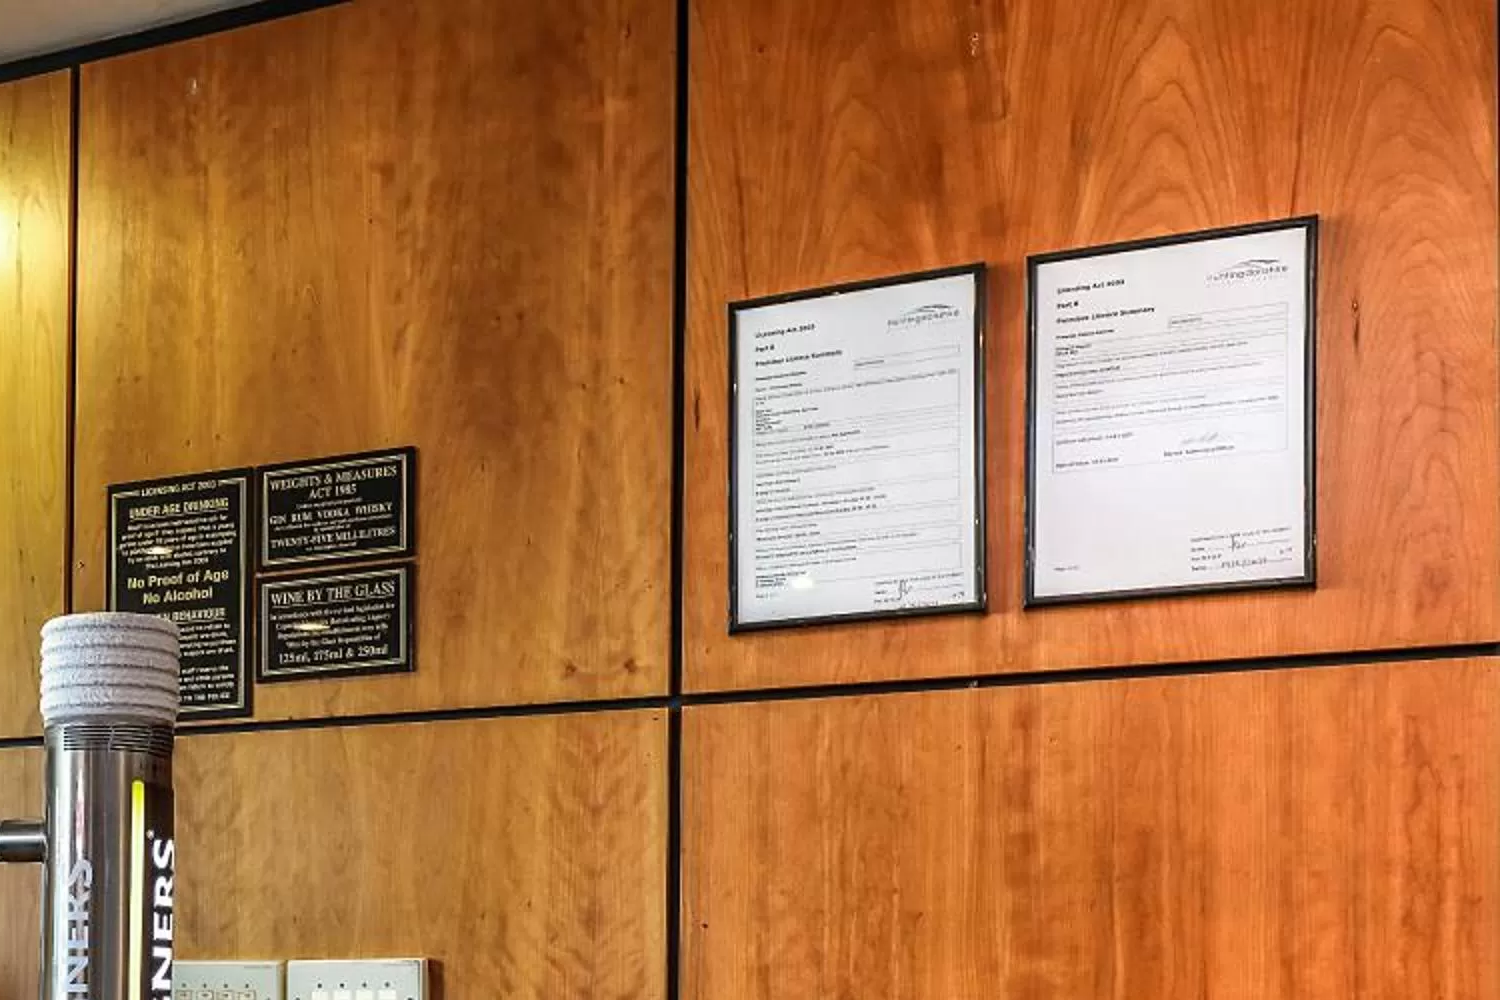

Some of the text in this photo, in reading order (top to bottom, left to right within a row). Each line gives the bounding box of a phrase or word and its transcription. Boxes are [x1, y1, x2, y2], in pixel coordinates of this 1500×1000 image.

[270, 464, 398, 491] WEIGHTS & MEASURES
[309, 487, 332, 500] ACT
[269, 514, 287, 525] GIN
[127, 569, 230, 590] No Proof of Age
[143, 586, 213, 605] No Alcohol
[270, 581, 396, 605] WINE BY THE GLASS
